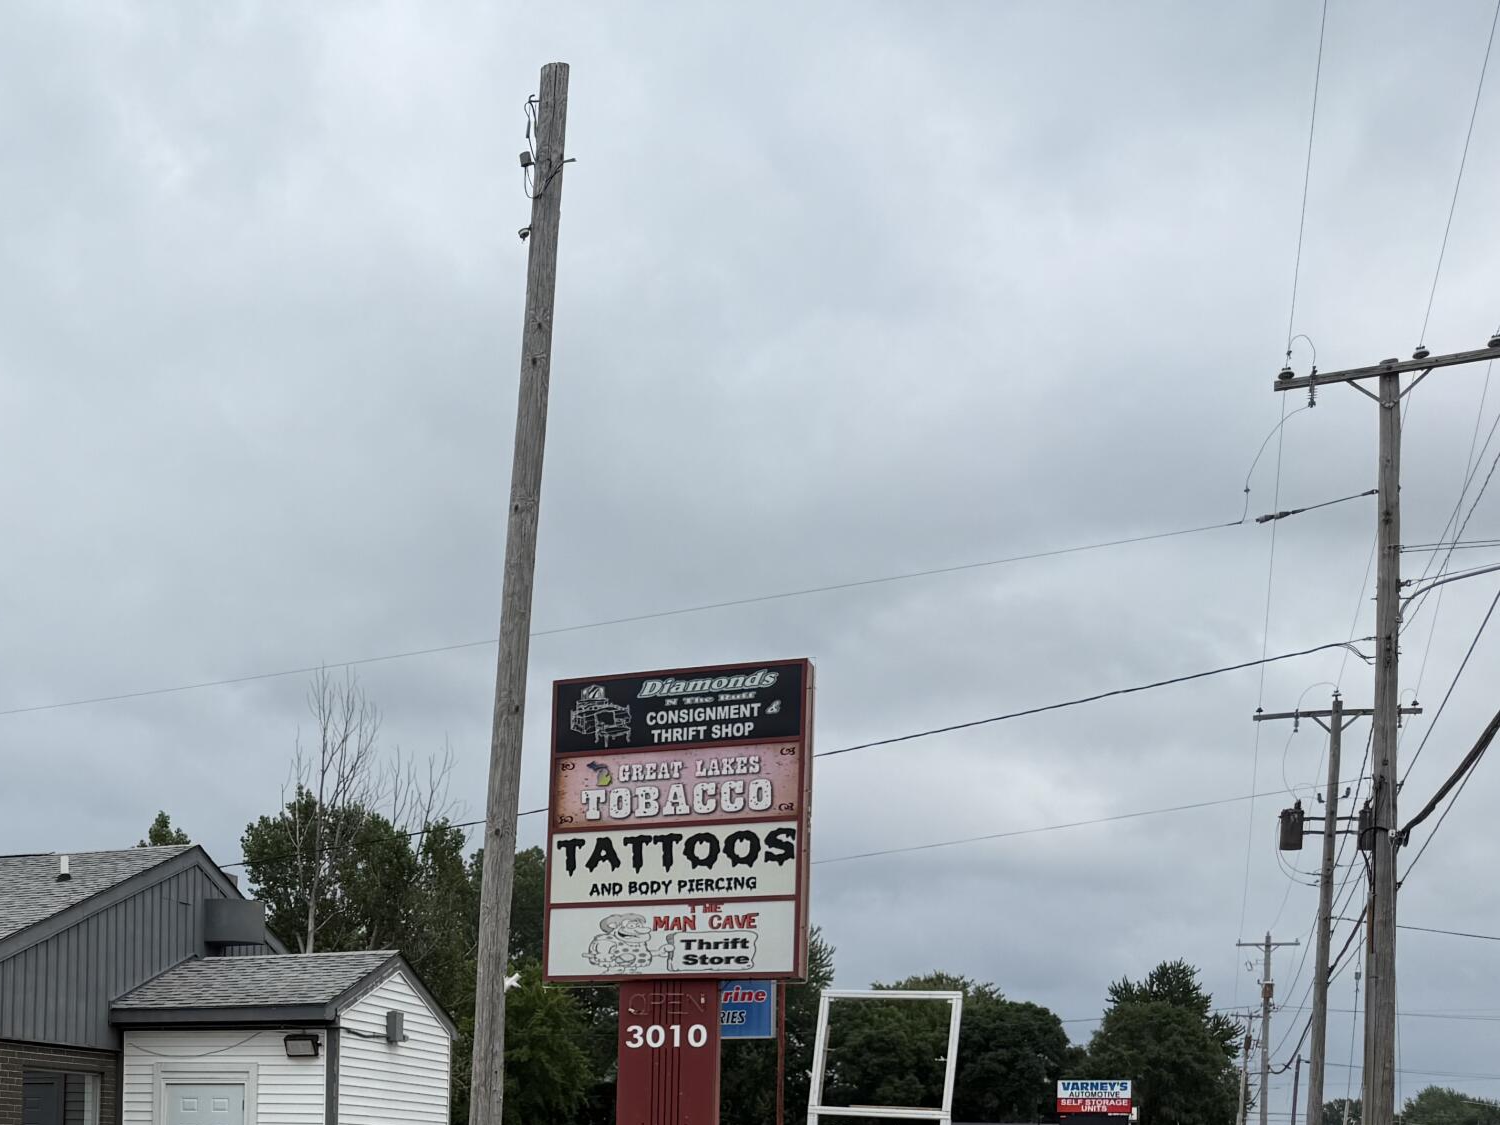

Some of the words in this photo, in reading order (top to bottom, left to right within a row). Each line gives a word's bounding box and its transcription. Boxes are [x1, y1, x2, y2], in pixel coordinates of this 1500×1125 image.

[637, 669, 780, 698] Diamonds
[682, 696, 714, 705] The
[646, 703, 761, 726] CONSIGNMENT
[765, 700, 782, 714] &
[651, 726, 707, 743] THRIFT
[711, 722, 755, 739] SHOP
[618, 761, 683, 782] GREAT
[695, 756, 761, 777] LAKES
[581, 778, 773, 820] TOBACCO
[557, 827, 796, 877] TATTOOS
[589, 882, 623, 896] AND
[628, 880, 672, 895] BODY
[677, 877, 757, 893] PIERCING
[688, 902, 723, 913] THE
[652, 915, 697, 932] MAN
[708, 912, 759, 930] CAVE
[680, 938, 750, 950] Thrift
[682, 954, 750, 965] Store
[722, 985, 767, 1003] rine
[720, 1010, 746, 1025] RIES
[625, 1024, 707, 1048] 3010
[1061, 1082, 1128, 1091] VARNEY'S
